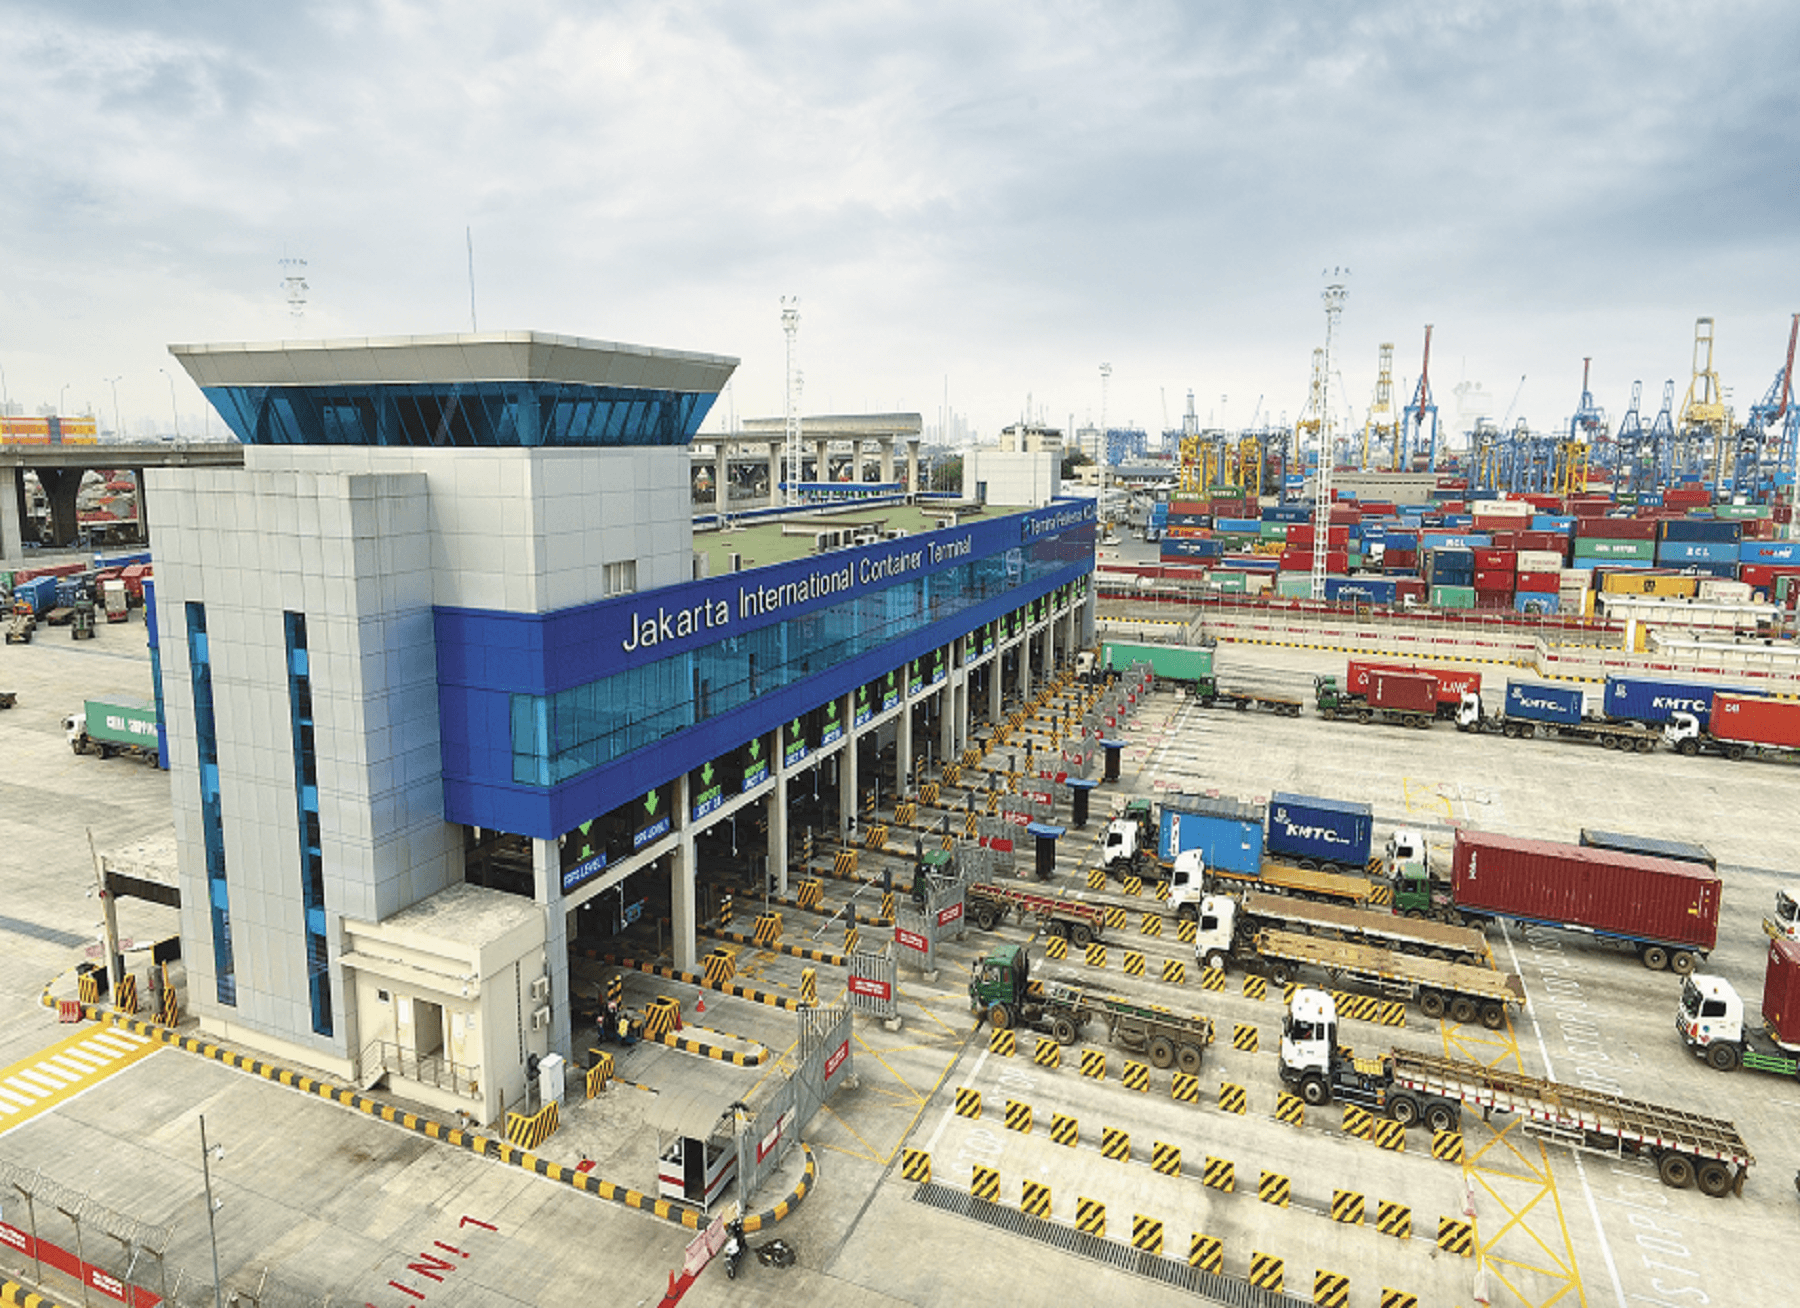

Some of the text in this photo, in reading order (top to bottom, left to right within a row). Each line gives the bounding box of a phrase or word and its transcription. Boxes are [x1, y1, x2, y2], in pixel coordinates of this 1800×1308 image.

[623, 535, 971, 651] Jakarta International Container Terminal
[1652, 697, 1705, 712] KMTC
[1284, 823, 1337, 843] KMTC
[1626, 1212, 1711, 1304] STOP
